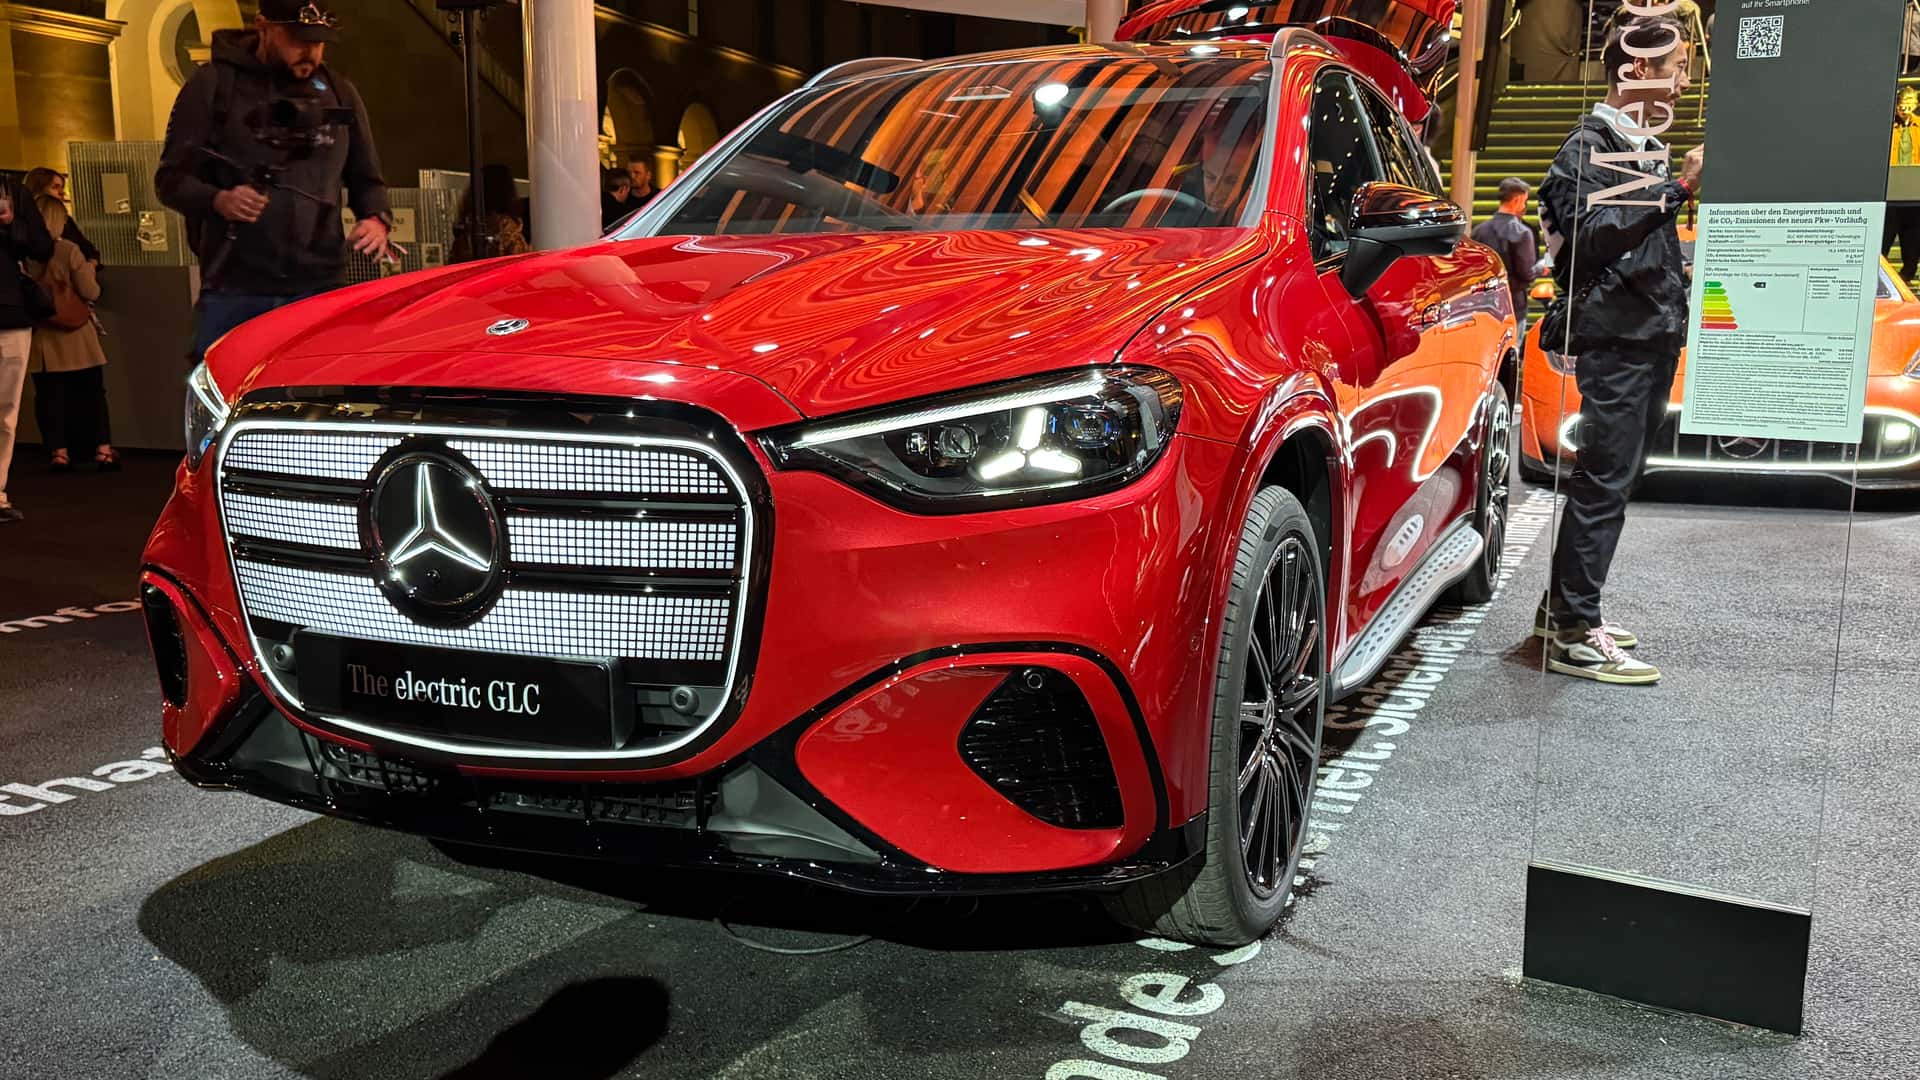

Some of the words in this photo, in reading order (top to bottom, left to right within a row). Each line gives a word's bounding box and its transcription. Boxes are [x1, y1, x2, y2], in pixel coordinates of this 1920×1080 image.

[1709, 208, 1750, 216] Information
[1751, 208, 1767, 216] über
[1783, 208, 1846, 217] Energieverbrauch
[1847, 207, 1862, 215] und
[1834, 216, 1868, 225] Vorläufig
[0, 598, 142, 633] mfo
[347, 663, 389, 697] The
[395, 670, 481, 709] electric
[488, 680, 541, 716] GLC
